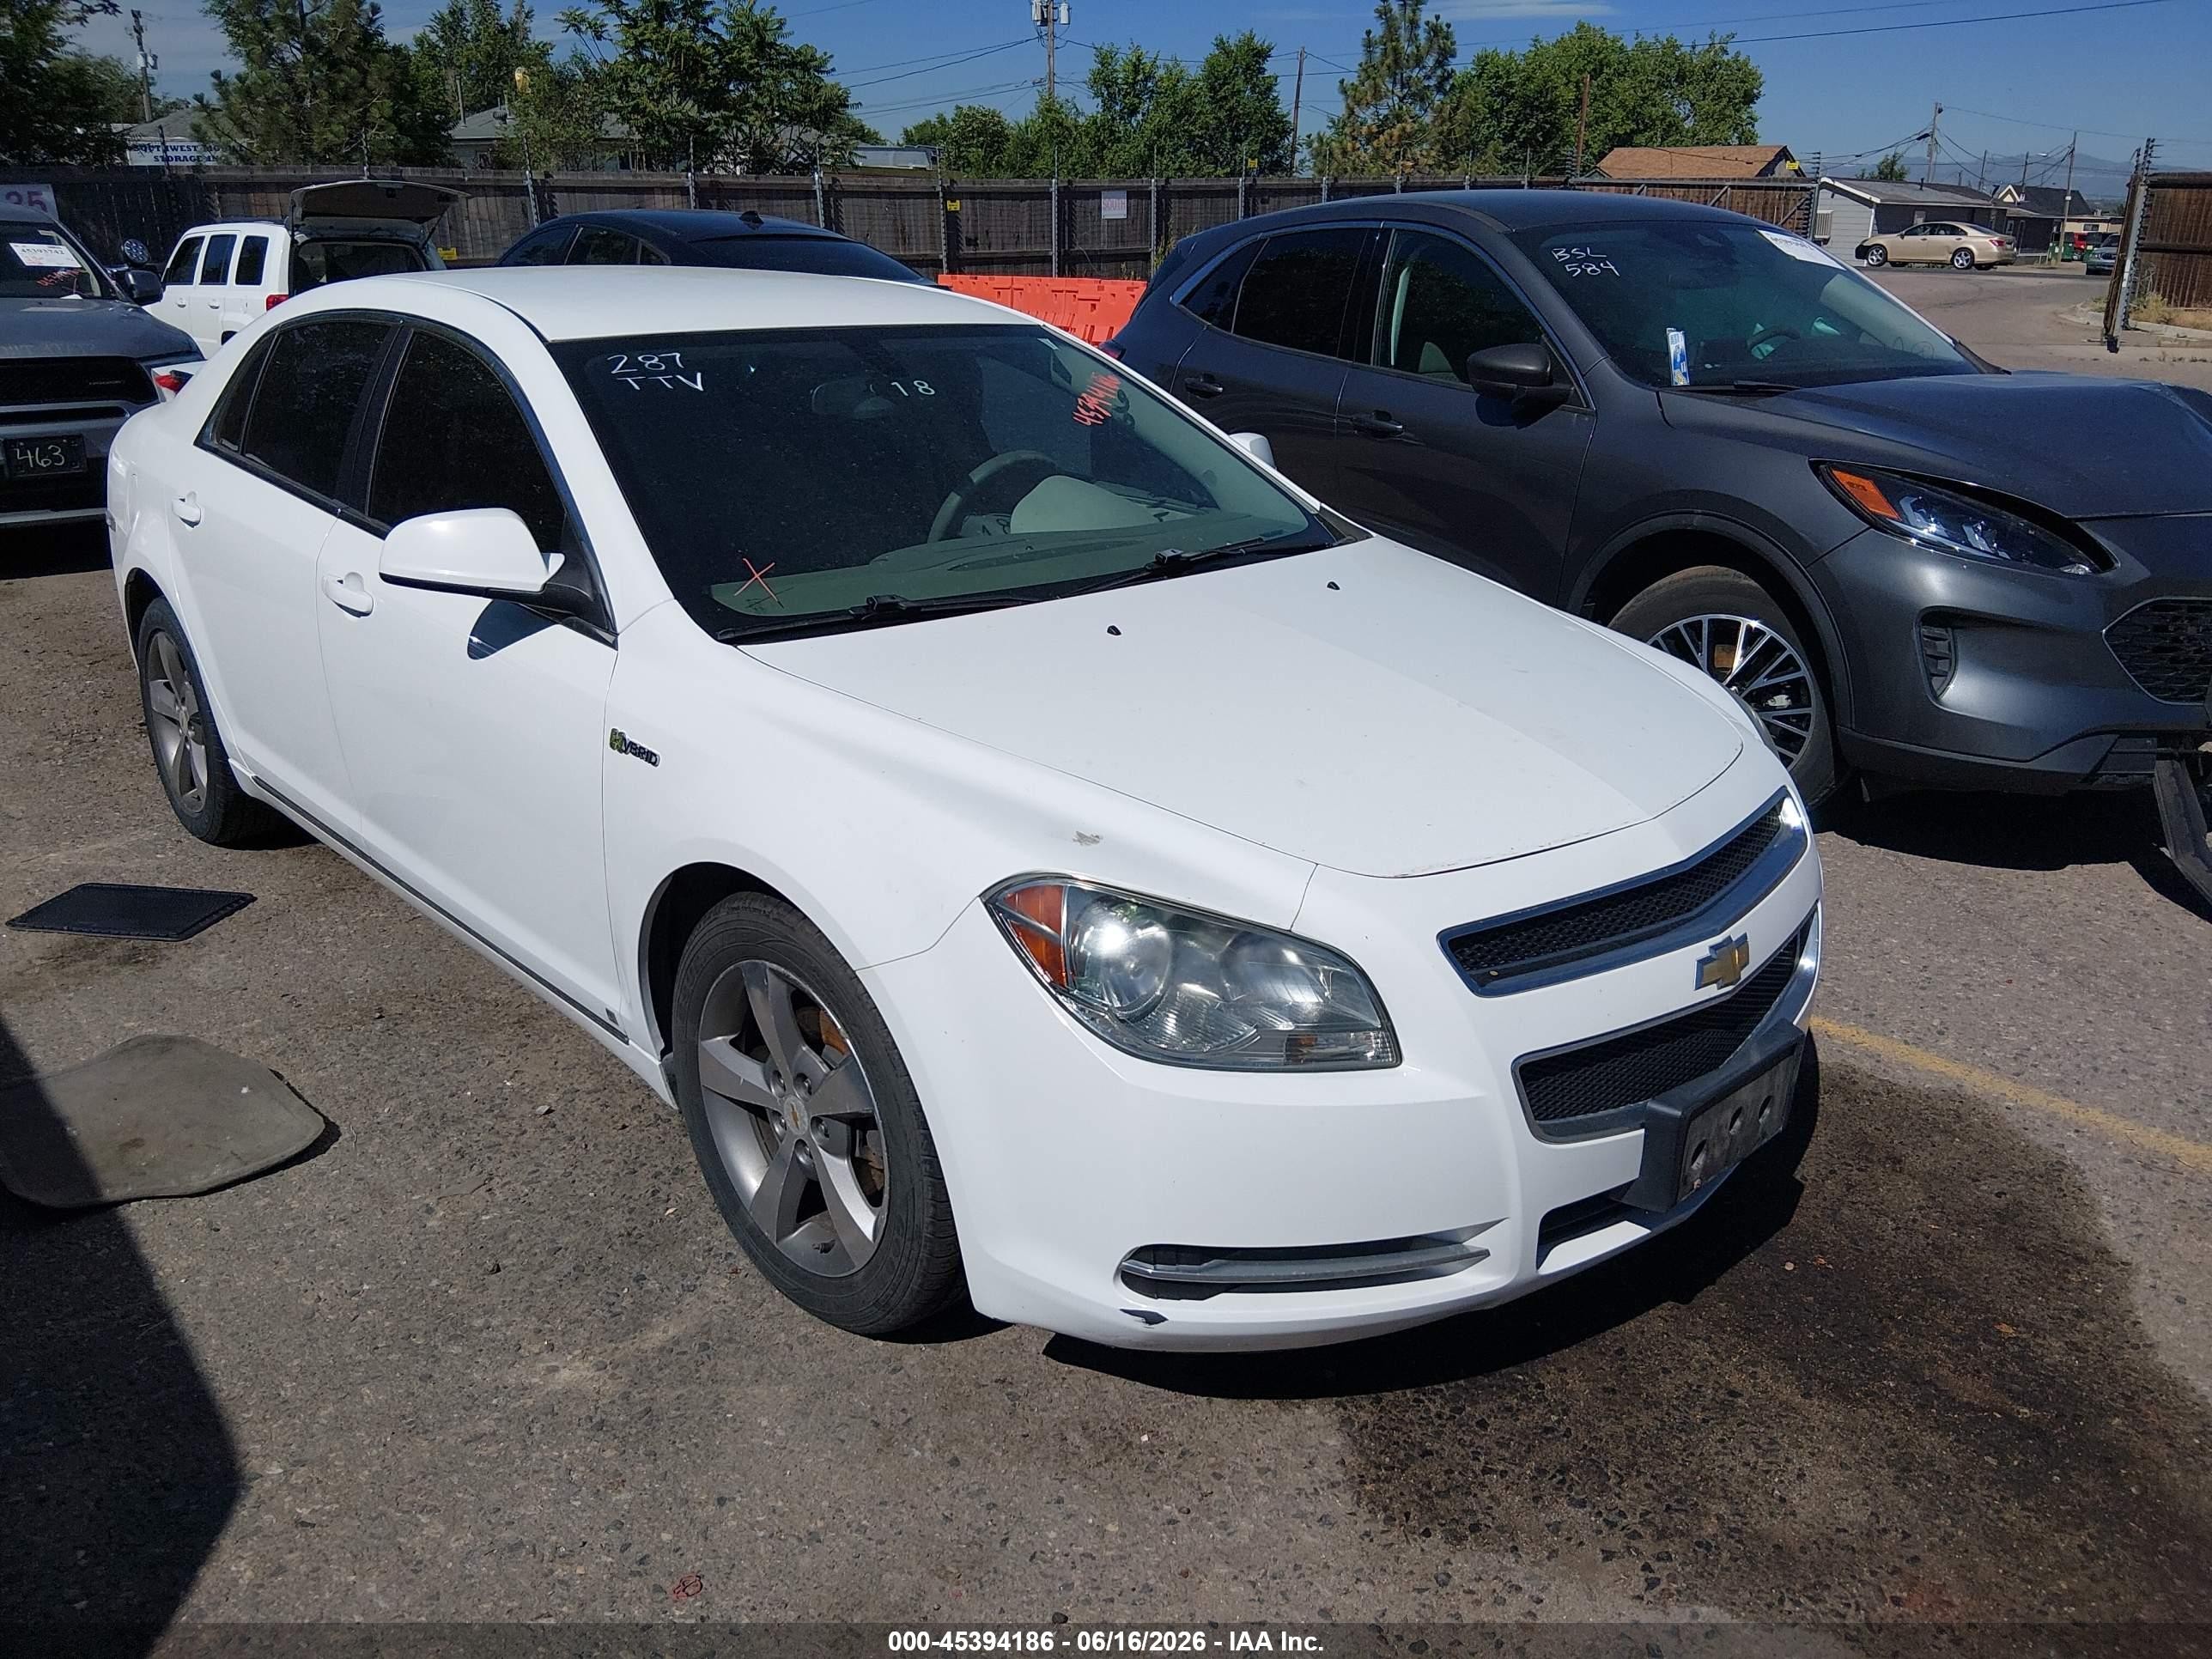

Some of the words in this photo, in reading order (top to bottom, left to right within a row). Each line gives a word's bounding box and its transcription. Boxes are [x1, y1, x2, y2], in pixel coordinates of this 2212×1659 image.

[1552, 247, 1607, 262] BSL
[1565, 260, 1620, 276] 584
[607, 352, 684, 374] 287
[617, 372, 703, 391] TTV
[890, 380, 935, 396] 18
[14, 445, 65, 467] 463
